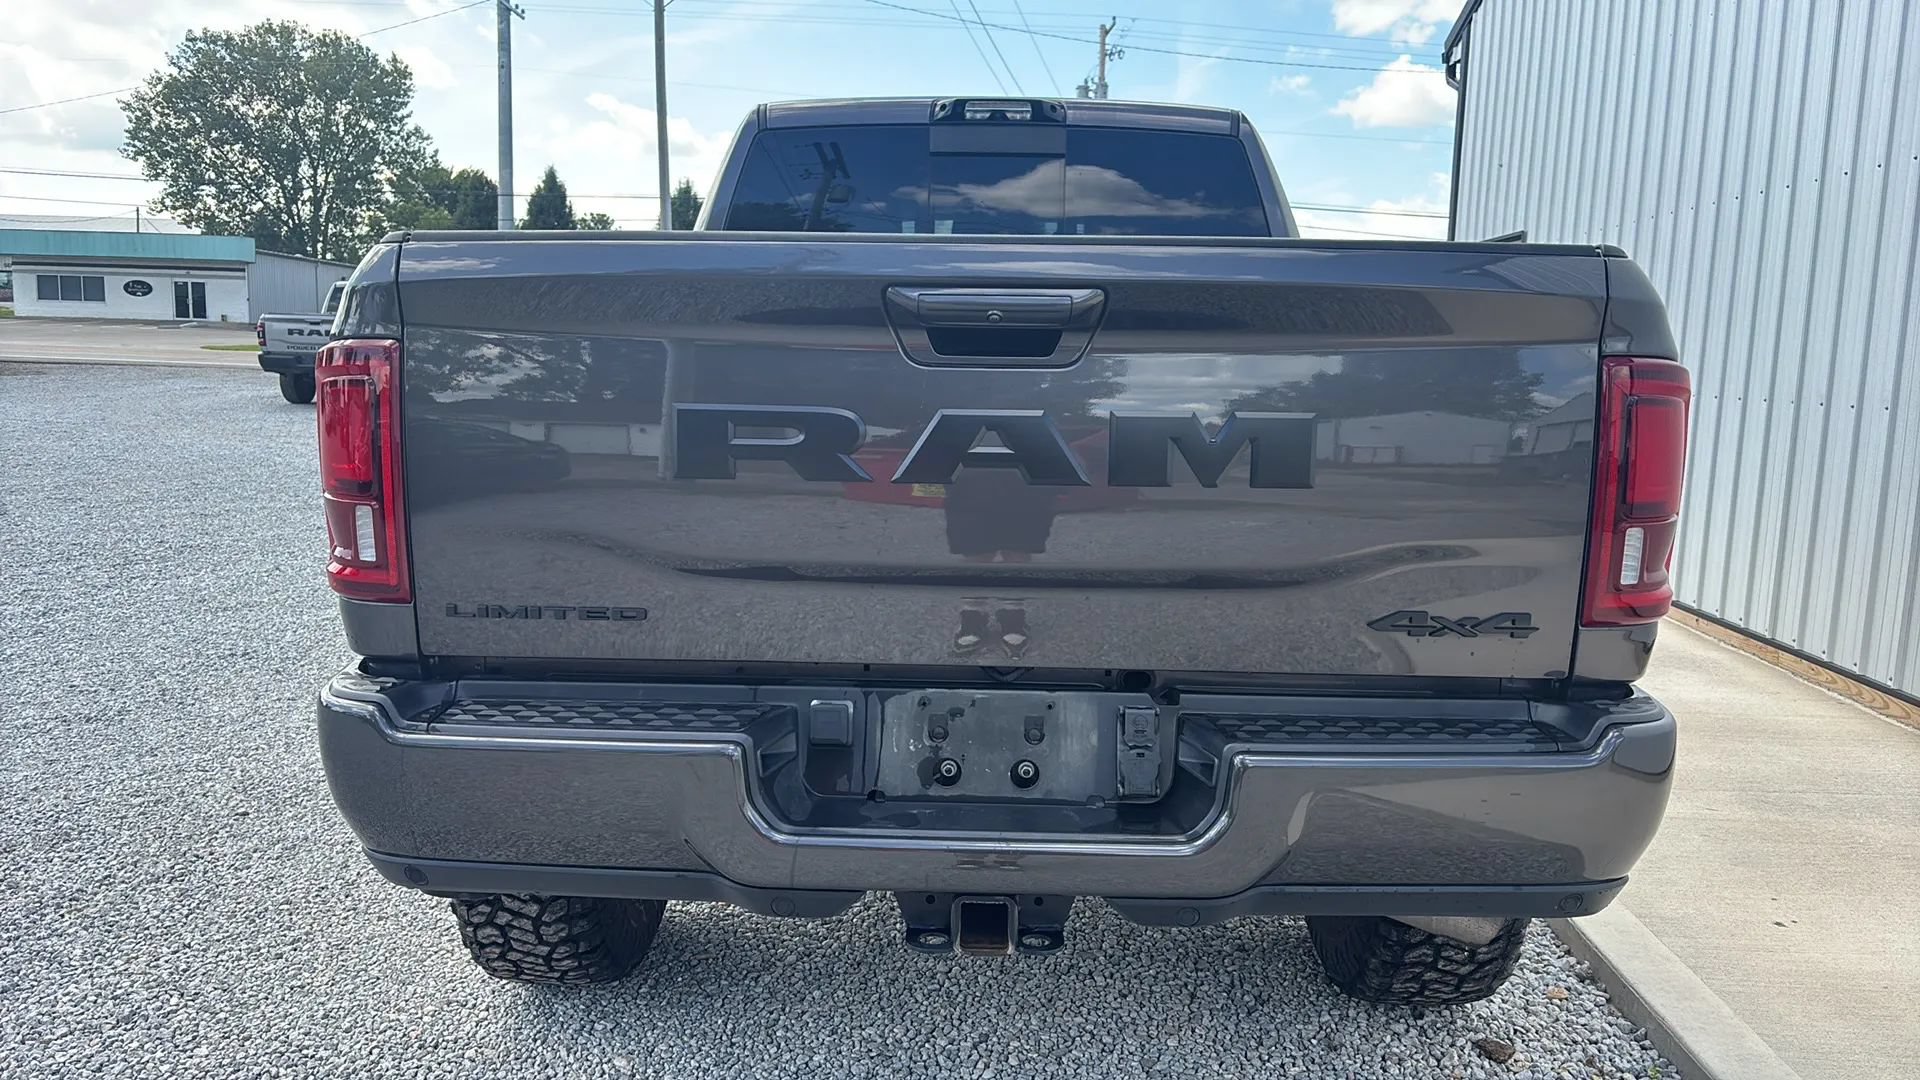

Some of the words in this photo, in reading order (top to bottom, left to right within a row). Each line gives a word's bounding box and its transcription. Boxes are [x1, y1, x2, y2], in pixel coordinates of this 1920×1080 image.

[674, 403, 1318, 488] RAM
[445, 603, 648, 621] LIMITED
[1367, 610, 1540, 639] 4x4
